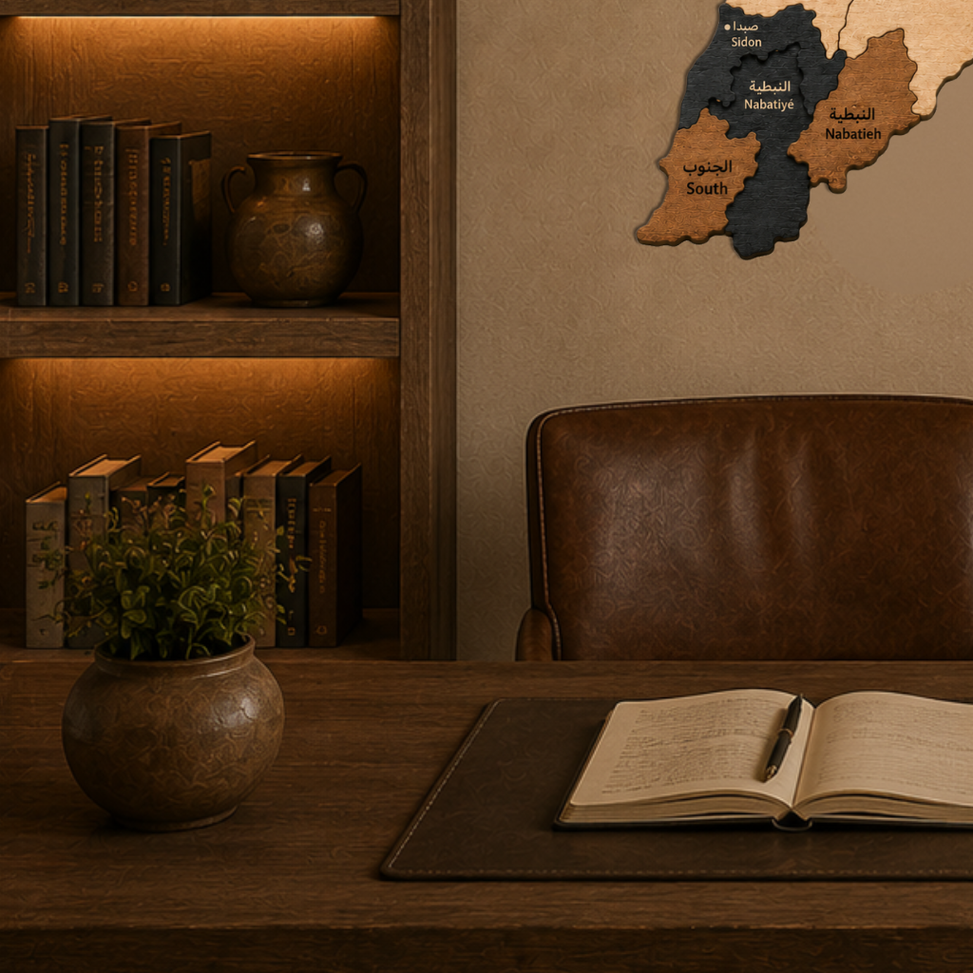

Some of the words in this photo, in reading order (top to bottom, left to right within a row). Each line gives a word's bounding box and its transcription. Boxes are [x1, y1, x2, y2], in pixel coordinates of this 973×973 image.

[731, 35, 762, 48] Sidon
[749, 80, 791, 95] النبطية
[744, 98, 795, 113] Nabatiyé
[829, 107, 875, 124] النبطية
[825, 127, 882, 140] Nabatieh
[682, 159, 733, 177] الجنوب
[686, 181, 728, 196] South
